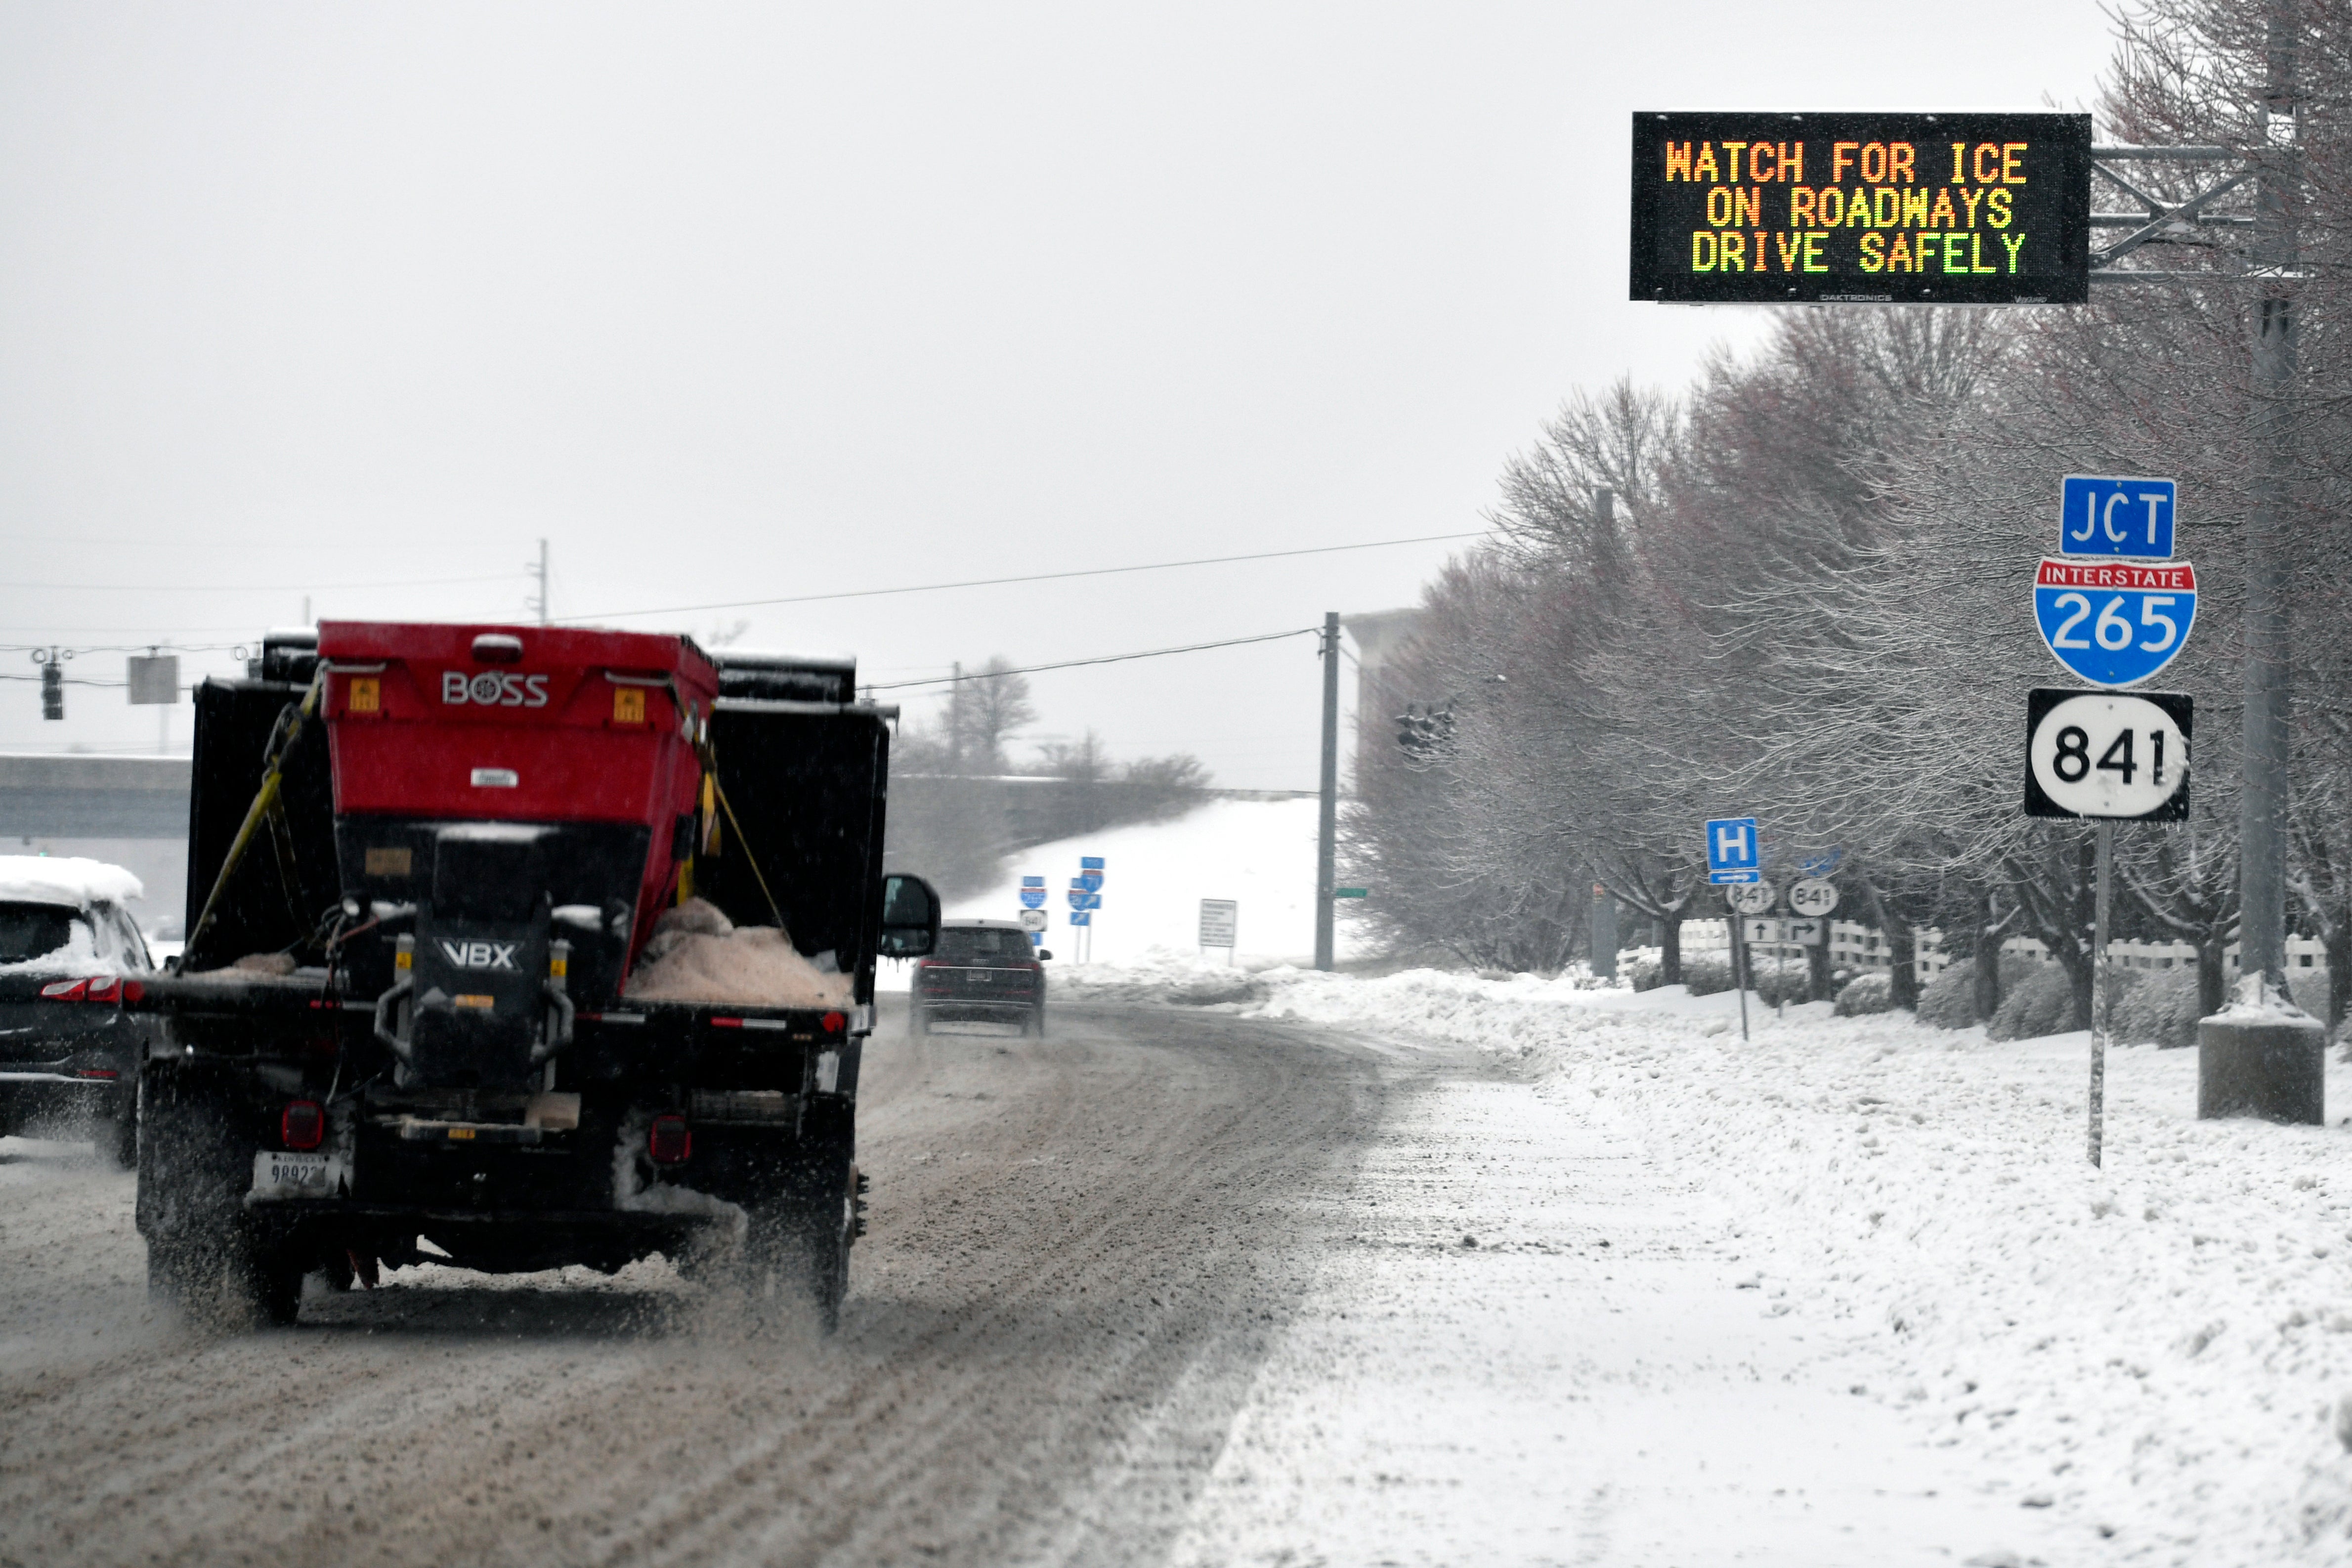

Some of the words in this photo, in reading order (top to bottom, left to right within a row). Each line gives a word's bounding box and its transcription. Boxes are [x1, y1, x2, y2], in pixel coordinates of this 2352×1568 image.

[1666, 141, 1803, 182] WATCH
[1833, 141, 1915, 183] FOR
[1951, 142, 2027, 184] ICE
[1707, 187, 1760, 227] ON
[1790, 187, 2012, 228] ROADWAYS
[1692, 231, 1829, 272] DRIVE
[1859, 232, 2026, 274] SAFELY
[2070, 491, 2168, 544] JCT
[2046, 567, 2184, 587] INTERSTATE
[2053, 593, 2177, 652] 265
[442, 670, 549, 708] BOSS
[2053, 725, 2164, 785] 841
[1716, 826, 1749, 862] H
[1794, 887, 1831, 905] 841
[442, 941, 515, 969] VBX
